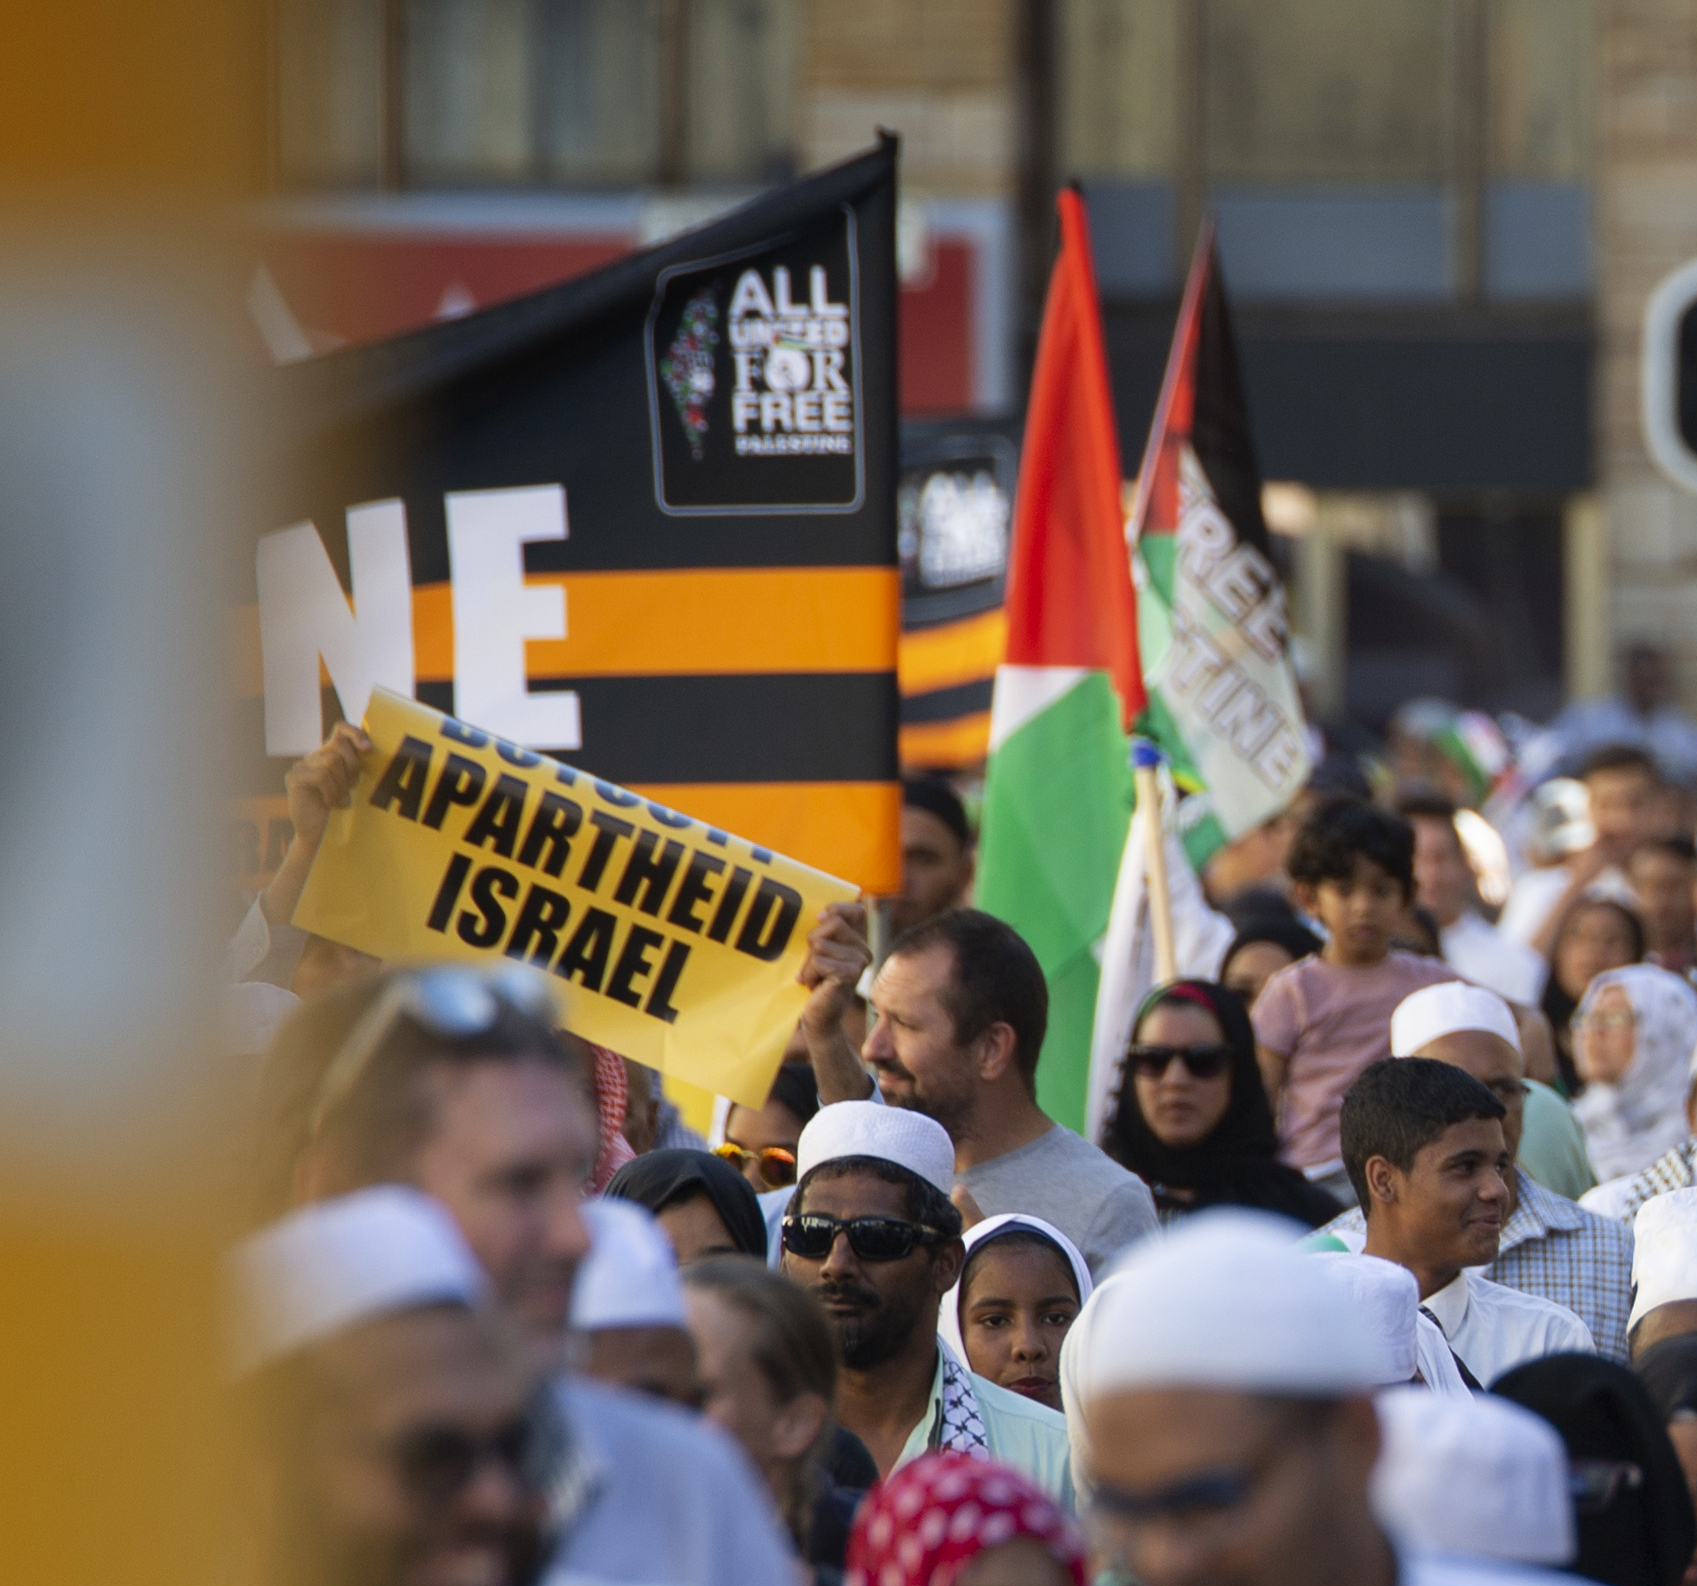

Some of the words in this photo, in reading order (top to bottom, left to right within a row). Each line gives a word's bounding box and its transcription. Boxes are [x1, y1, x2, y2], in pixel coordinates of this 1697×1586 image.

[728, 264, 849, 319] ALL
[732, 391, 852, 432] FREE
[733, 349, 851, 392] FOR
[735, 433, 852, 456] PALESTINE
[1180, 480, 1292, 664] REE
[1170, 606, 1300, 792] TINE
[368, 734, 803, 963] APARTHEID
[427, 850, 693, 1025] ISRAEL
